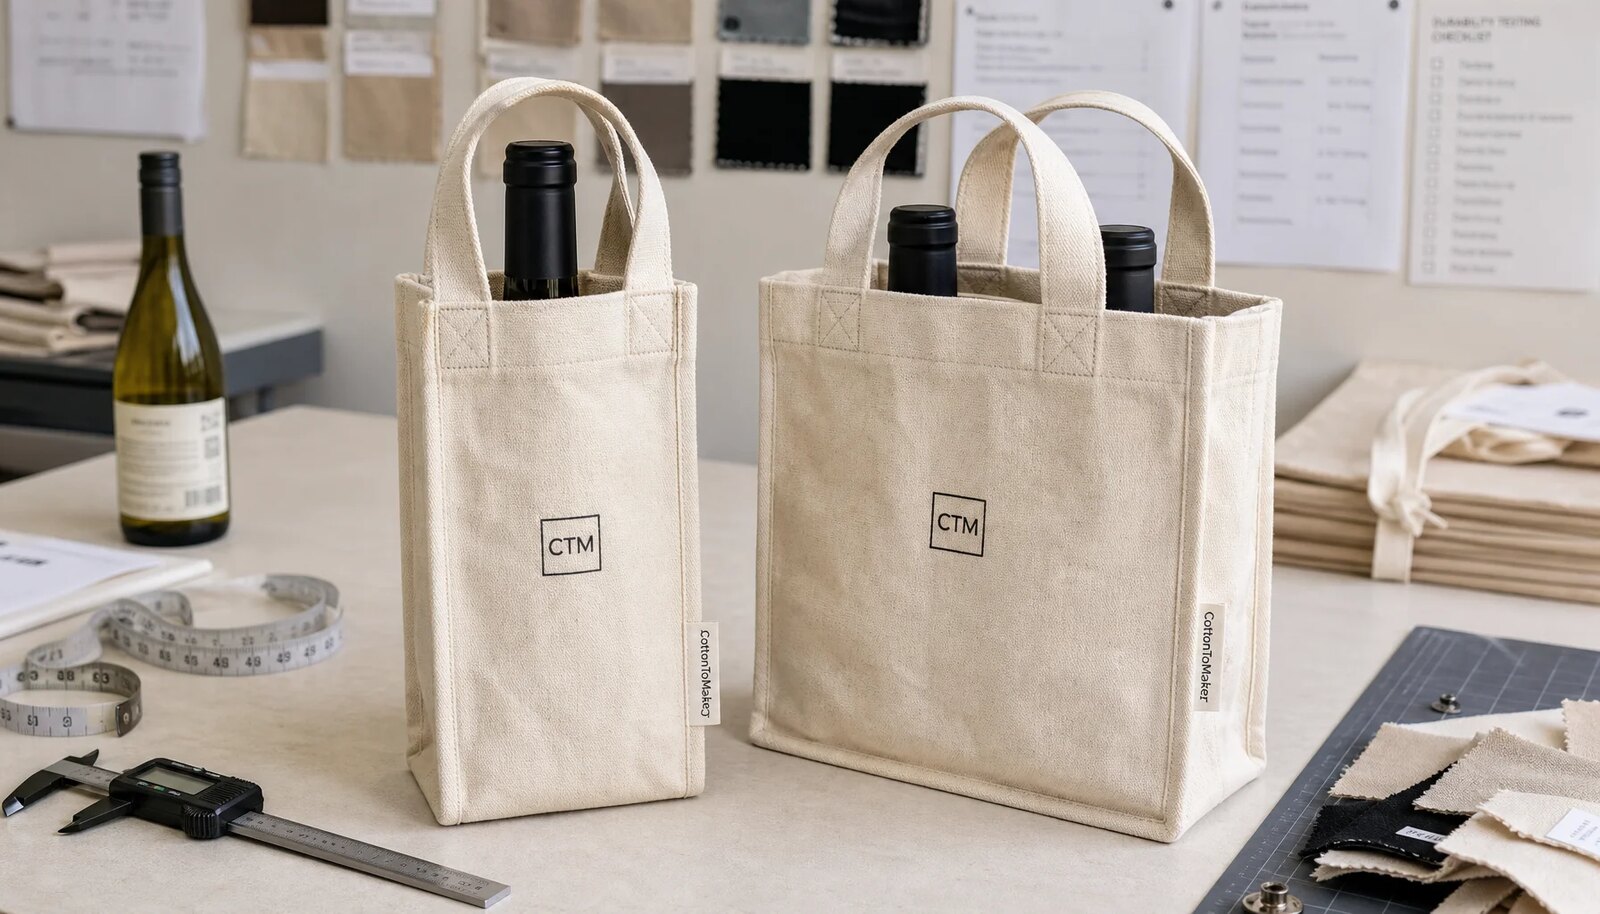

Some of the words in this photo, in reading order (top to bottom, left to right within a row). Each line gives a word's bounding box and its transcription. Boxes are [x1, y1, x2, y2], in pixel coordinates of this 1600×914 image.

[937, 512, 978, 536] CTM
[548, 535, 594, 556] CTM
[1200, 611, 1214, 703] CottonToMaker
